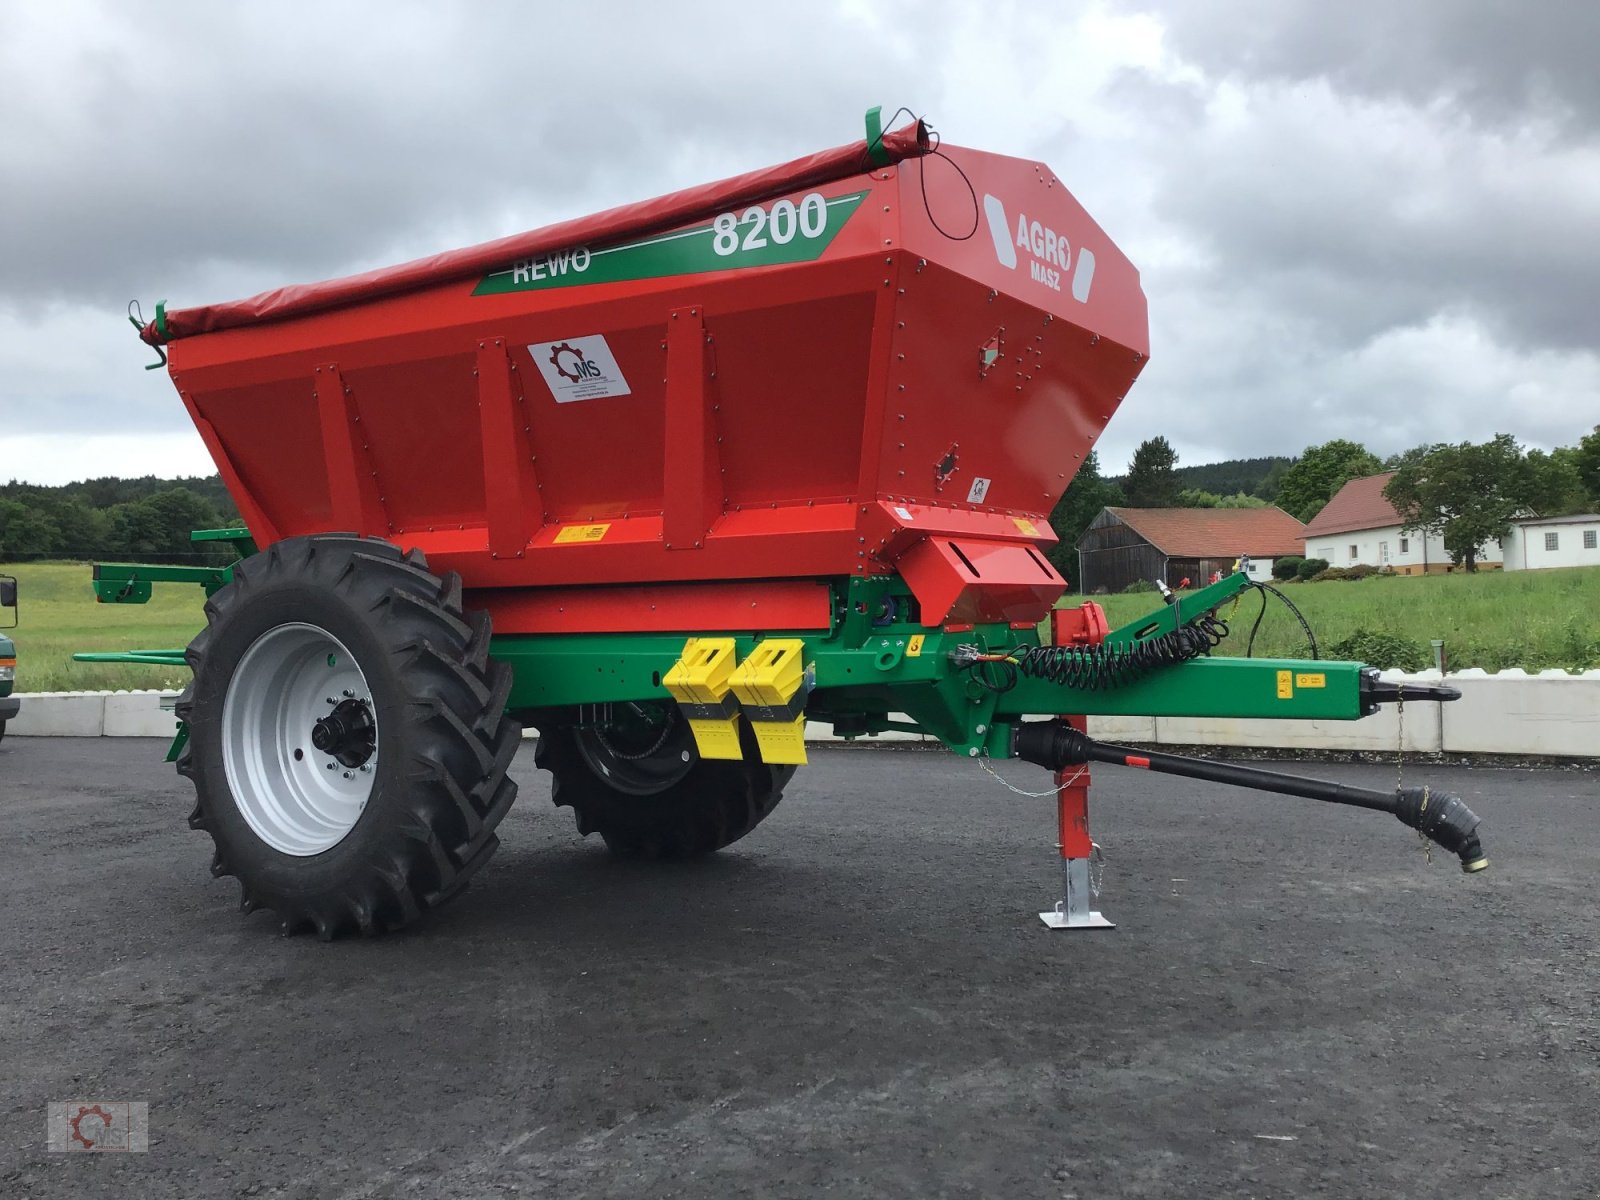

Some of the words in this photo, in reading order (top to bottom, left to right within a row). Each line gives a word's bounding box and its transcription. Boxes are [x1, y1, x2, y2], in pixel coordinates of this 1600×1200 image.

[513, 246, 591, 284] REWO
[713, 192, 828, 257] 8200
[1016, 213, 1071, 271] AGRO
[1030, 259, 1061, 292] MASZ
[573, 360, 601, 379] MS
